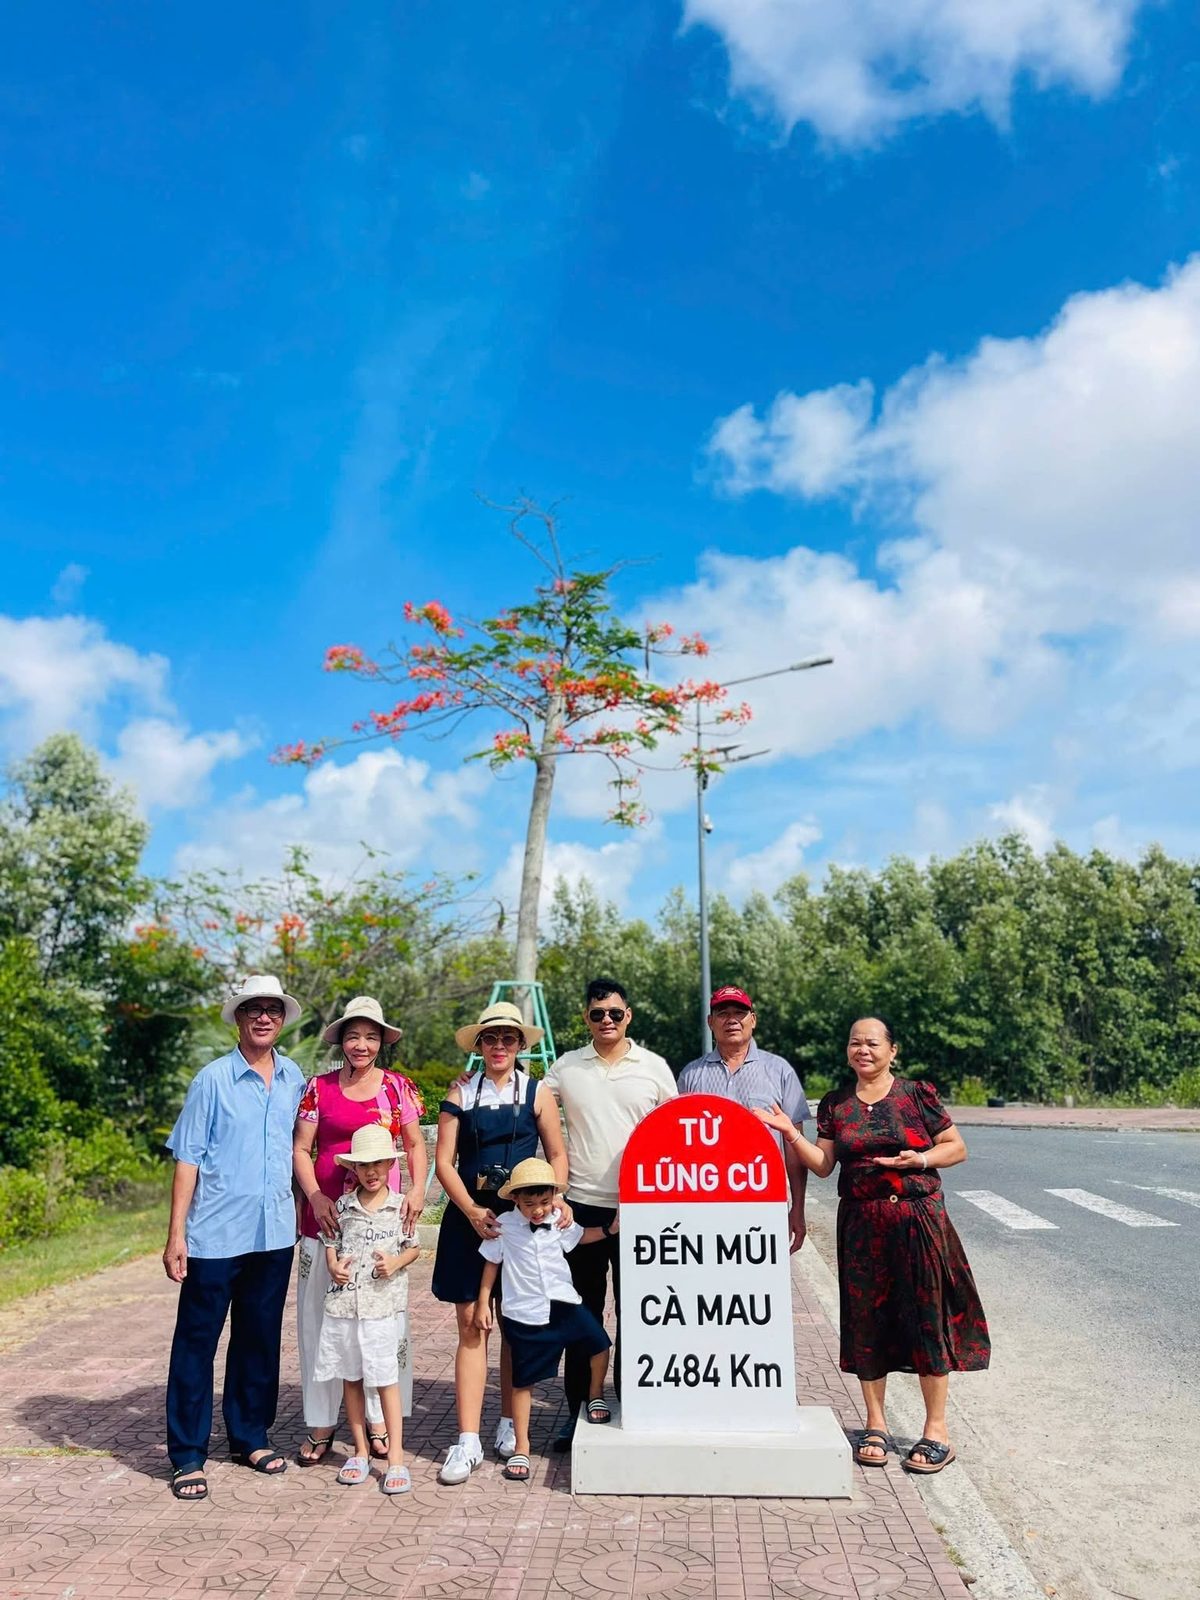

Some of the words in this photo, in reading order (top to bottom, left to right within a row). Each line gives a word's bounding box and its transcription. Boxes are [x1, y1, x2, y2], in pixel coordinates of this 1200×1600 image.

[679, 1110, 723, 1145] TỪ
[637, 1157, 719, 1192] LŨNG
[728, 1155, 768, 1192] CÚ
[633, 1222, 704, 1265] ĐẾN
[717, 1226, 777, 1265] MŨI
[641, 1285, 687, 1326] CÀ
[697, 1294, 772, 1326] MAU
[637, 1354, 720, 1388] 2.484
[731, 1354, 782, 1388] Km
